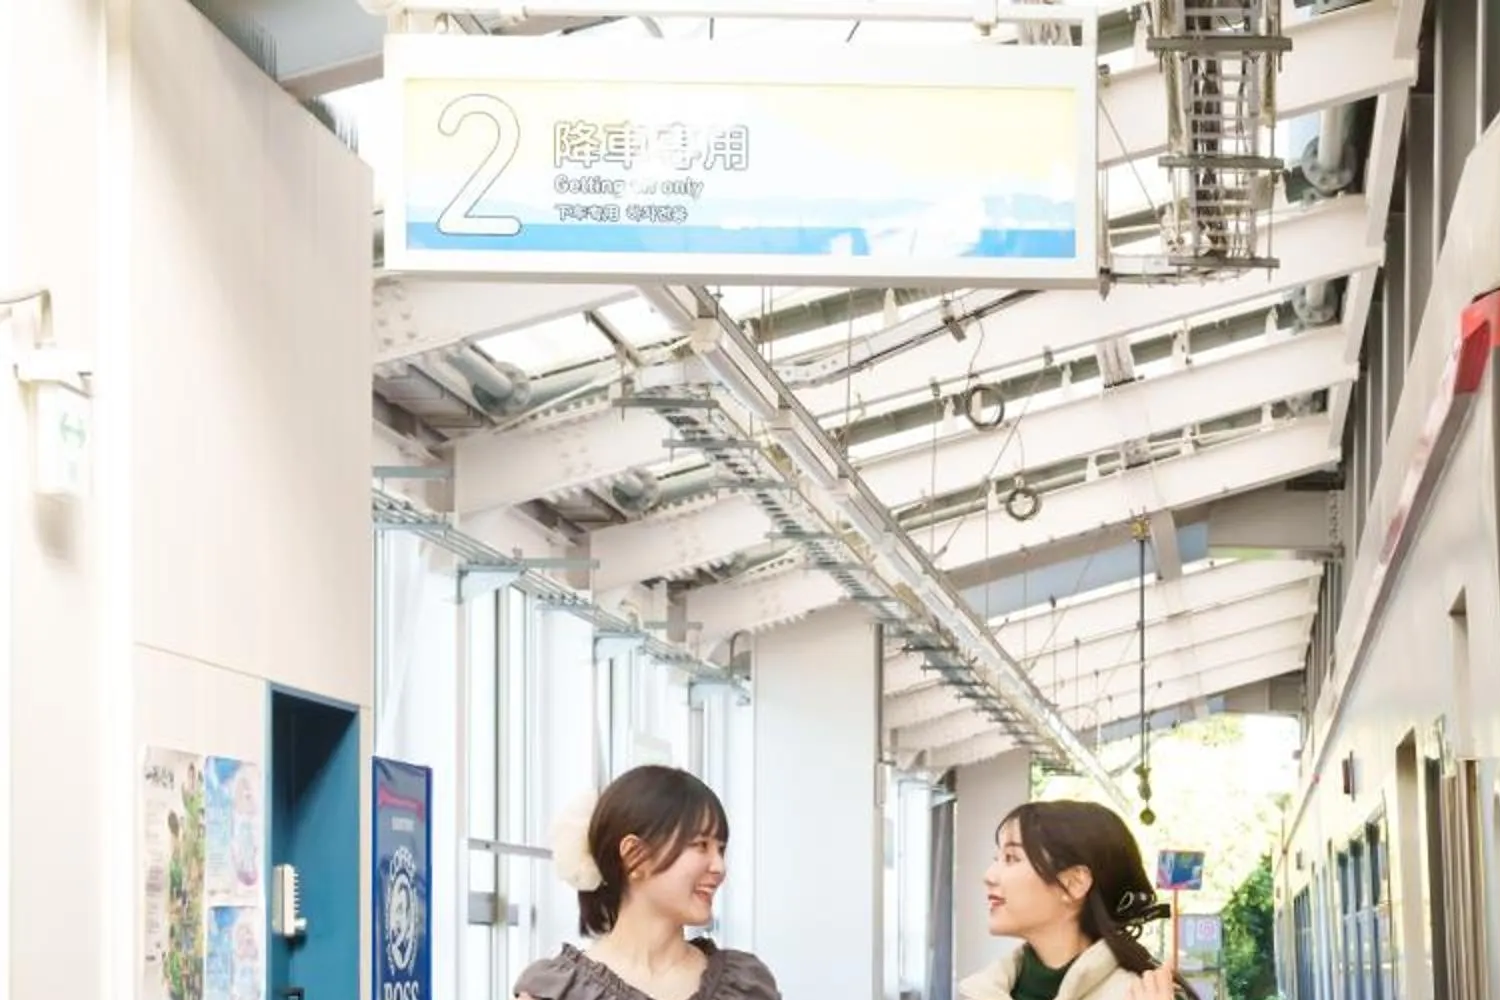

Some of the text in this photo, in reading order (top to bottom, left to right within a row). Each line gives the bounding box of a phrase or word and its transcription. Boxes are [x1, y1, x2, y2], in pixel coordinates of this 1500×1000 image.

[437, 93, 523, 237] 2
[554, 174, 626, 198] Getting
[661, 175, 704, 200] only
